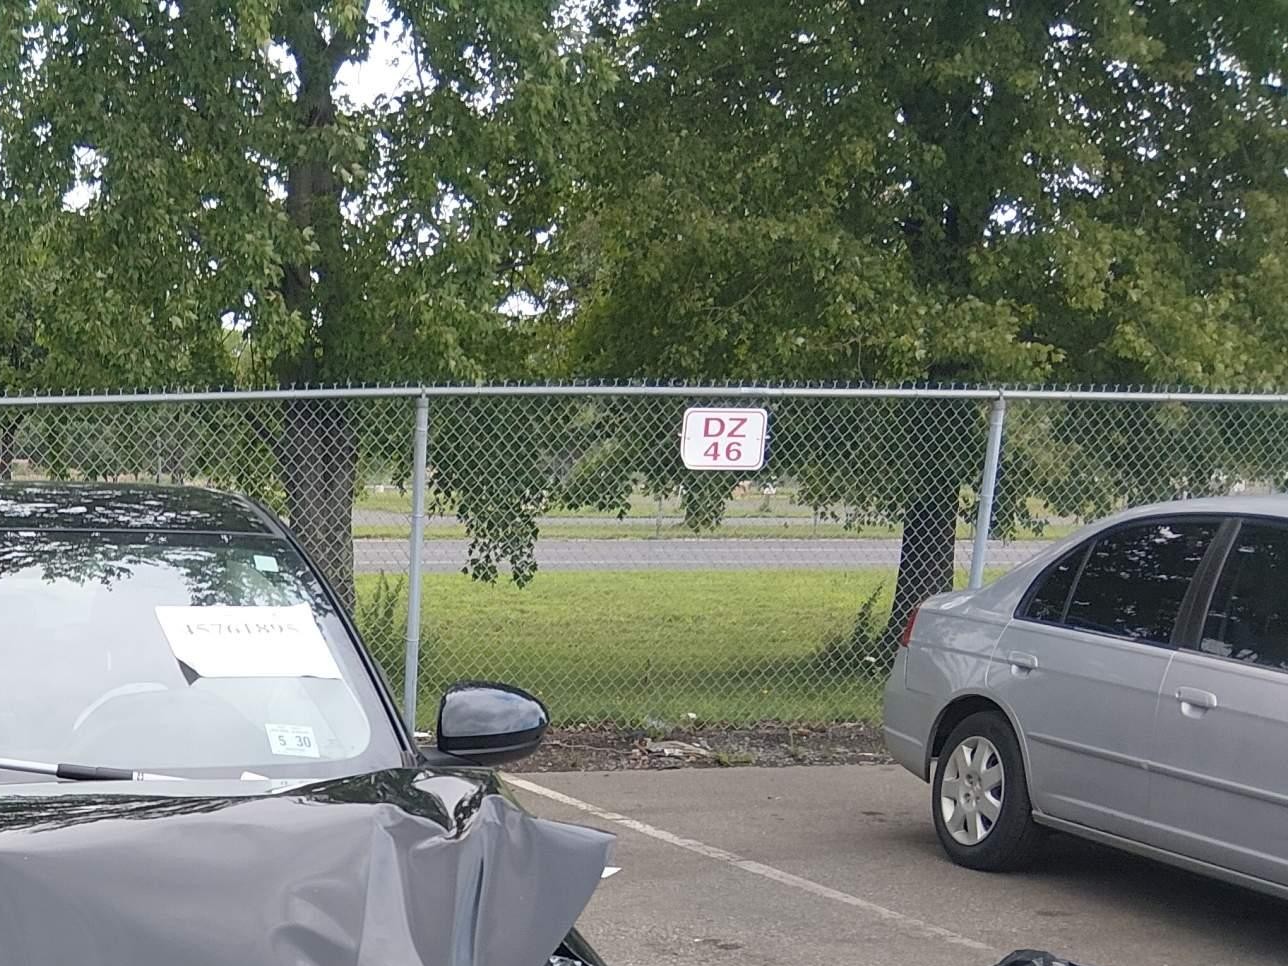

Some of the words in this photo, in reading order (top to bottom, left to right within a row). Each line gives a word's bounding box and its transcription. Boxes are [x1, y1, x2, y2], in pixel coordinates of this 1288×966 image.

[703, 417, 748, 438] DZ
[703, 441, 743, 462] 46
[278, 735, 287, 747] 5
[295, 735, 312, 749] 30
